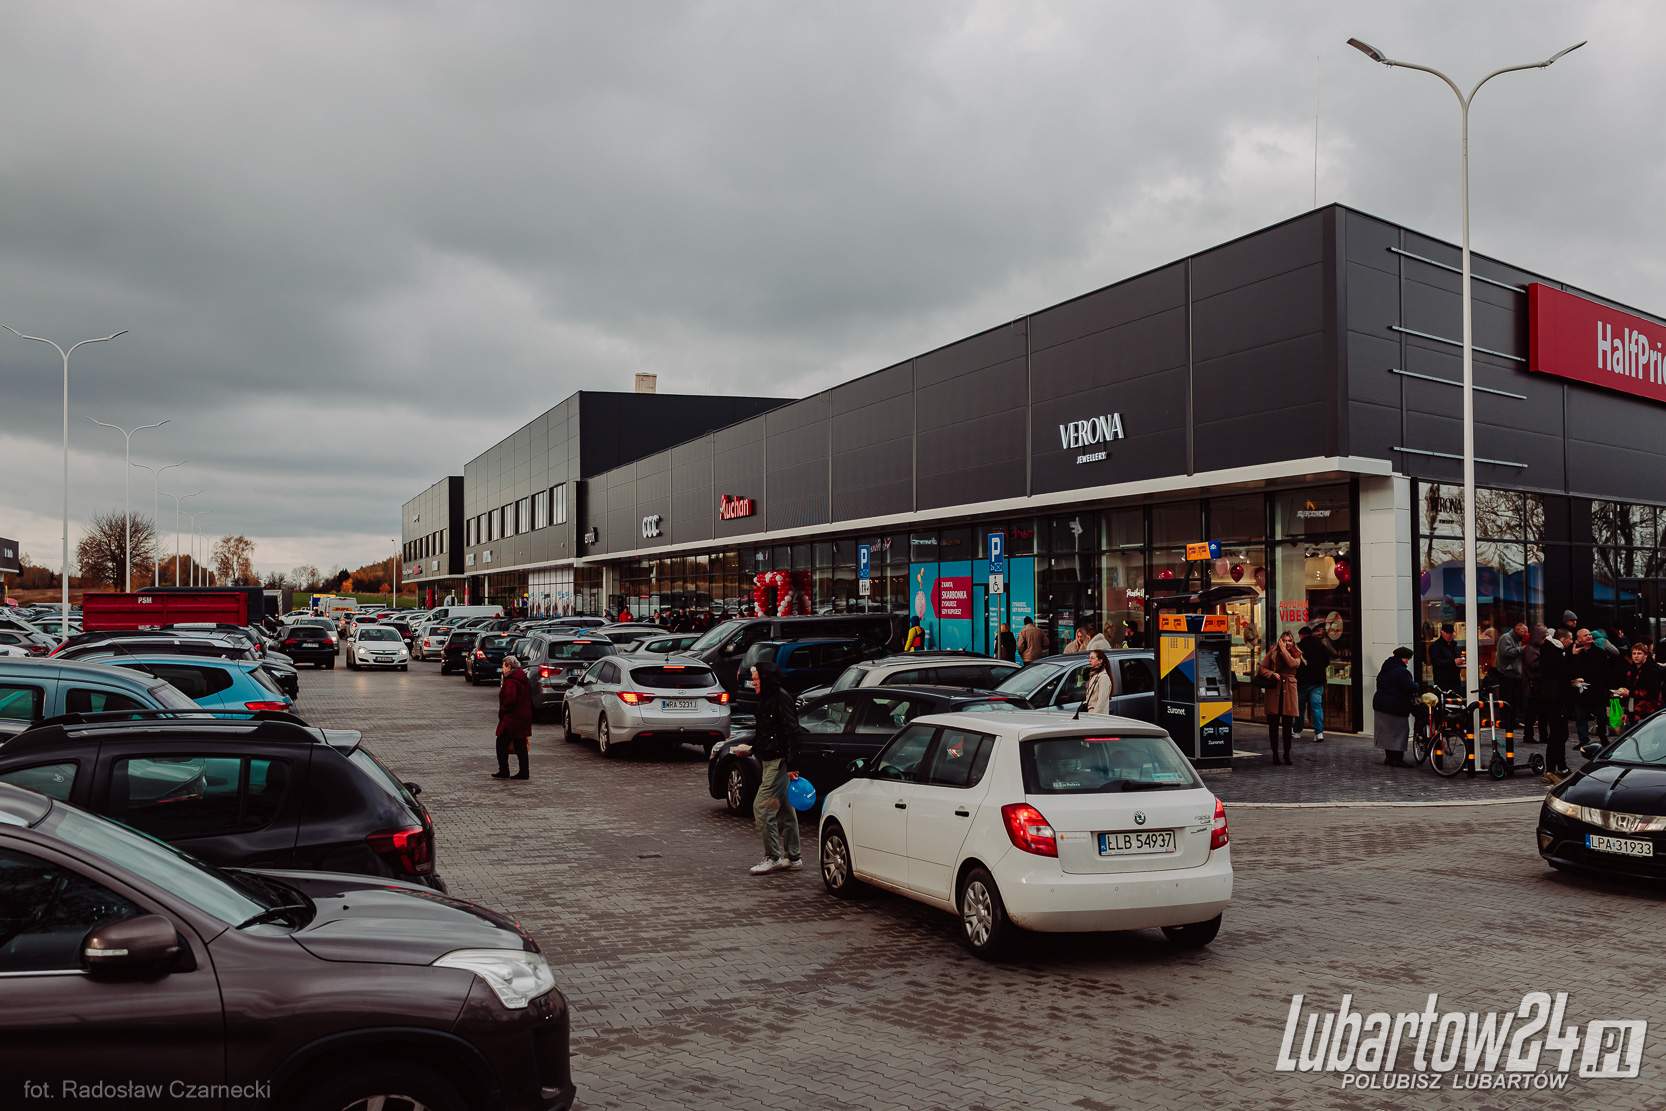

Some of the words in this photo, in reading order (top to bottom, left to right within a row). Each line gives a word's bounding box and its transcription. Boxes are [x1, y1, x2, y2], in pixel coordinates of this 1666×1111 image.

[1059, 412, 1124, 450] VERONA
[1076, 451, 1107, 465] JEWELLERY
[719, 495, 750, 521] Auchan
[642, 514, 660, 539] CCC
[860, 548, 868, 569] P
[992, 537, 1001, 562] P
[1280, 609, 1309, 623] VIBES
[1167, 705, 1186, 716] Euronet
[1107, 834, 1132, 850] LLB
[1136, 833, 1172, 850] 54937
[1591, 836, 1612, 850] LPA
[1615, 840, 1652, 855] 31933
